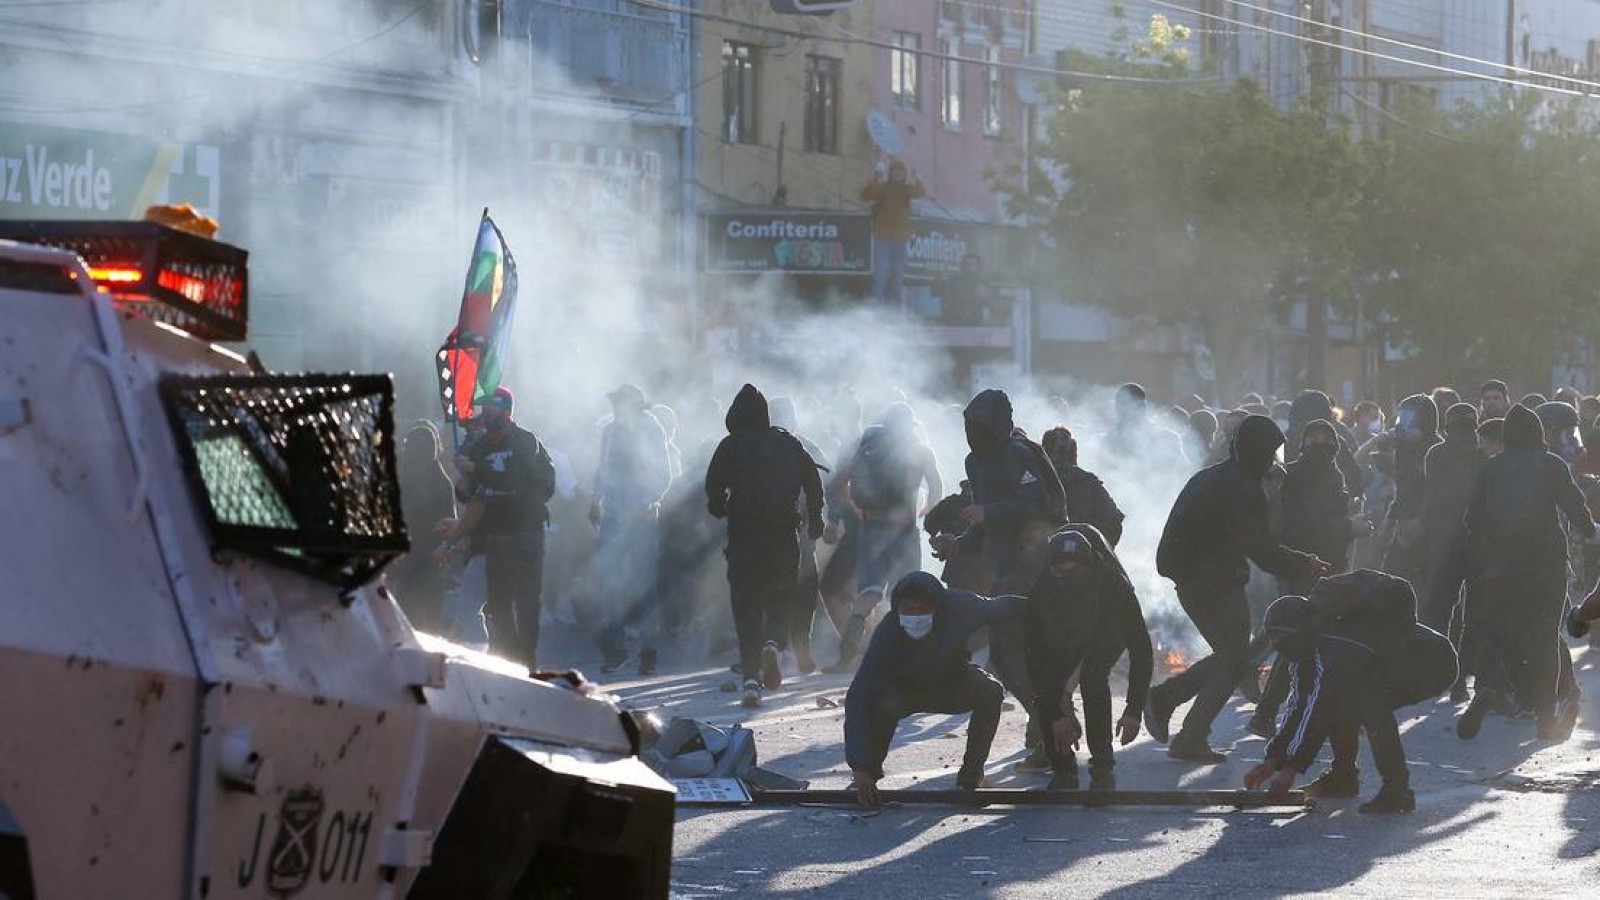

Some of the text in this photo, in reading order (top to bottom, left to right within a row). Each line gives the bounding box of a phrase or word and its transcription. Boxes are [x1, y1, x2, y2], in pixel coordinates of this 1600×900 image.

[26, 144, 111, 210] Verde
[238, 810, 373, 888] J 011
